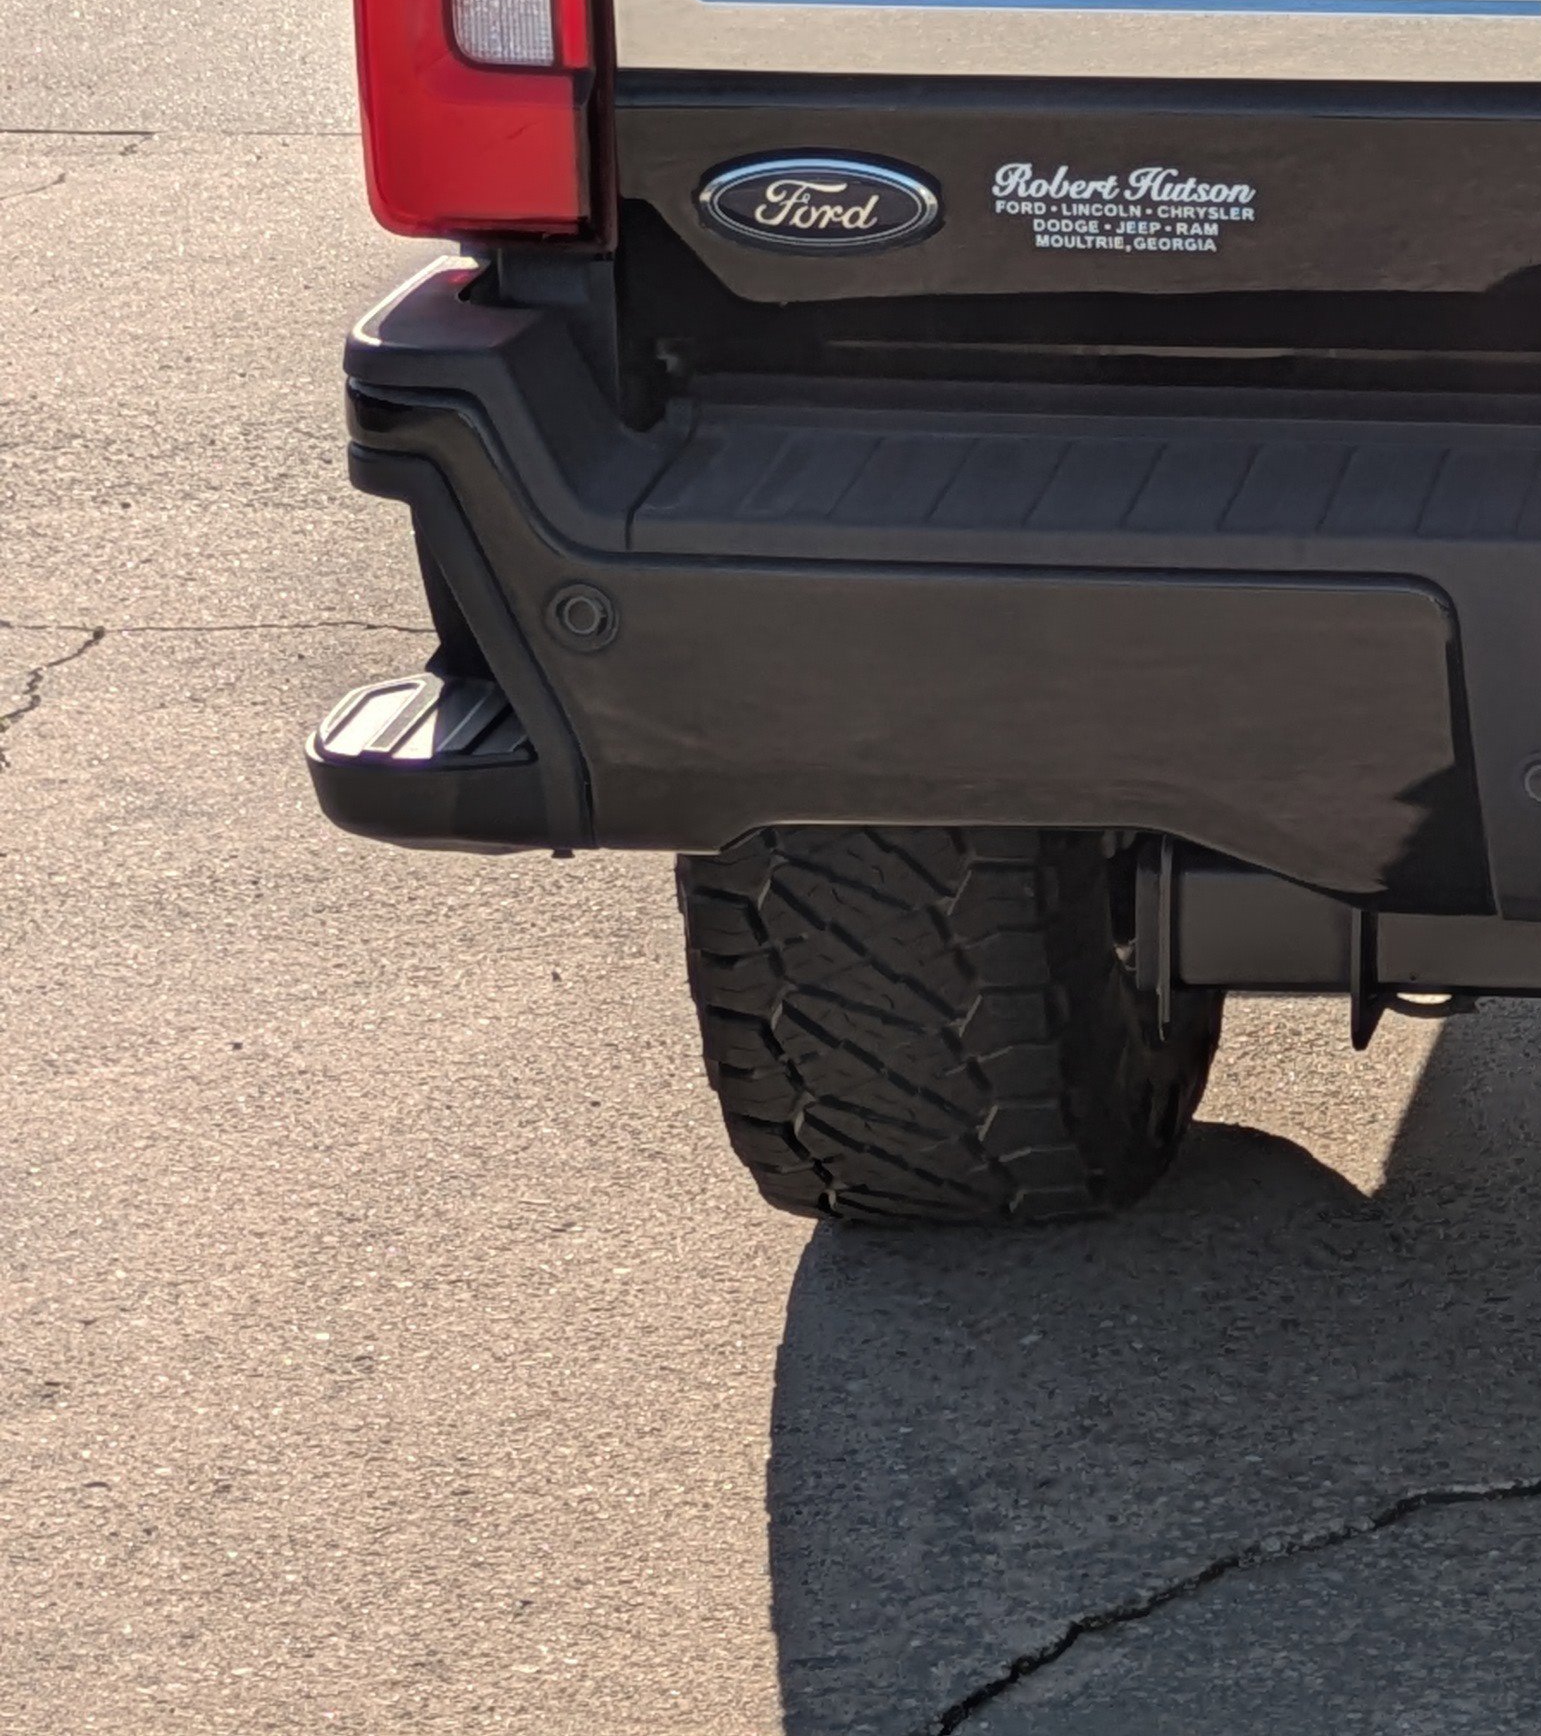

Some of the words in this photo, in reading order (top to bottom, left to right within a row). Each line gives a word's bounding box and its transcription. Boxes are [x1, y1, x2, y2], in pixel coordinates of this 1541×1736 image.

[992, 162, 1120, 201] Robert
[1123, 166, 1257, 203] Hutson
[754, 178, 880, 229] Ford
[995, 200, 1046, 215] FORD
[1061, 203, 1142, 217] LINCOLN
[1157, 205, 1256, 221] CHRYSLER
[1033, 219, 1100, 234] DODGE
[1116, 220, 1161, 234] JEEP
[1175, 222, 1219, 236] RAM
[1133, 237, 1217, 252] GEORGIA
